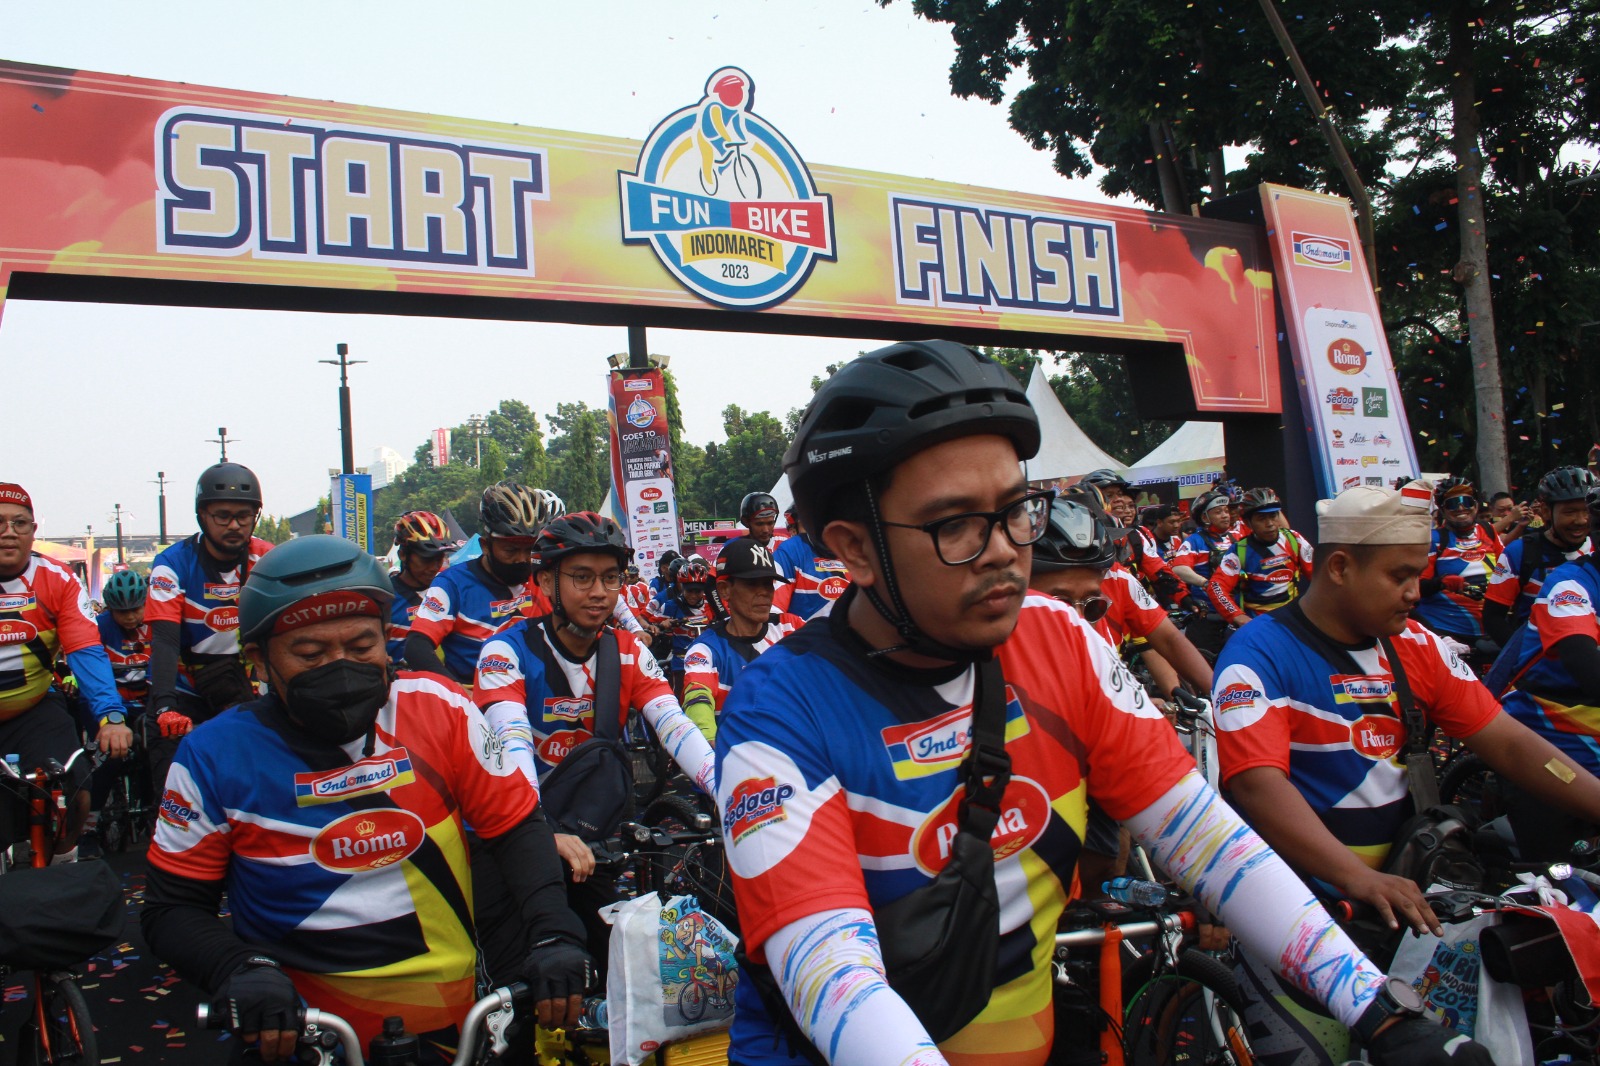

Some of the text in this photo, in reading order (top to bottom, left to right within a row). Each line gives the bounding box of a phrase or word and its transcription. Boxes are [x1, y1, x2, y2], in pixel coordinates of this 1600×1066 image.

[160, 110, 545, 272] START
[650, 192, 811, 239] FUN BIKE
[690, 232, 775, 263] INDOMARET
[1304, 243, 1342, 261] Indomaret
[893, 197, 1120, 316] FINISH
[721, 263, 750, 280] 2023
[1333, 348, 1362, 366] Roma
[1326, 393, 1359, 406] Sedaap
[622, 430, 656, 441] GOES TO
[807, 449, 827, 464] WEST
[627, 463, 643, 472] PLAZA
[1176, 473, 1204, 486] OODIE
[0, 490, 28, 502] YRIDE
[345, 512, 356, 541] SHBACK
[684, 522, 707, 531] MEN
[825, 584, 845, 595] Rom
[212, 614, 239, 626] Roma
[282, 600, 369, 625] CITYRIDE
[0, 631, 27, 641] oma
[548, 741, 571, 758] Ro
[319, 765, 392, 793] Indomaret
[331, 831, 408, 860] Roma
[680, 896, 700, 915] FU
